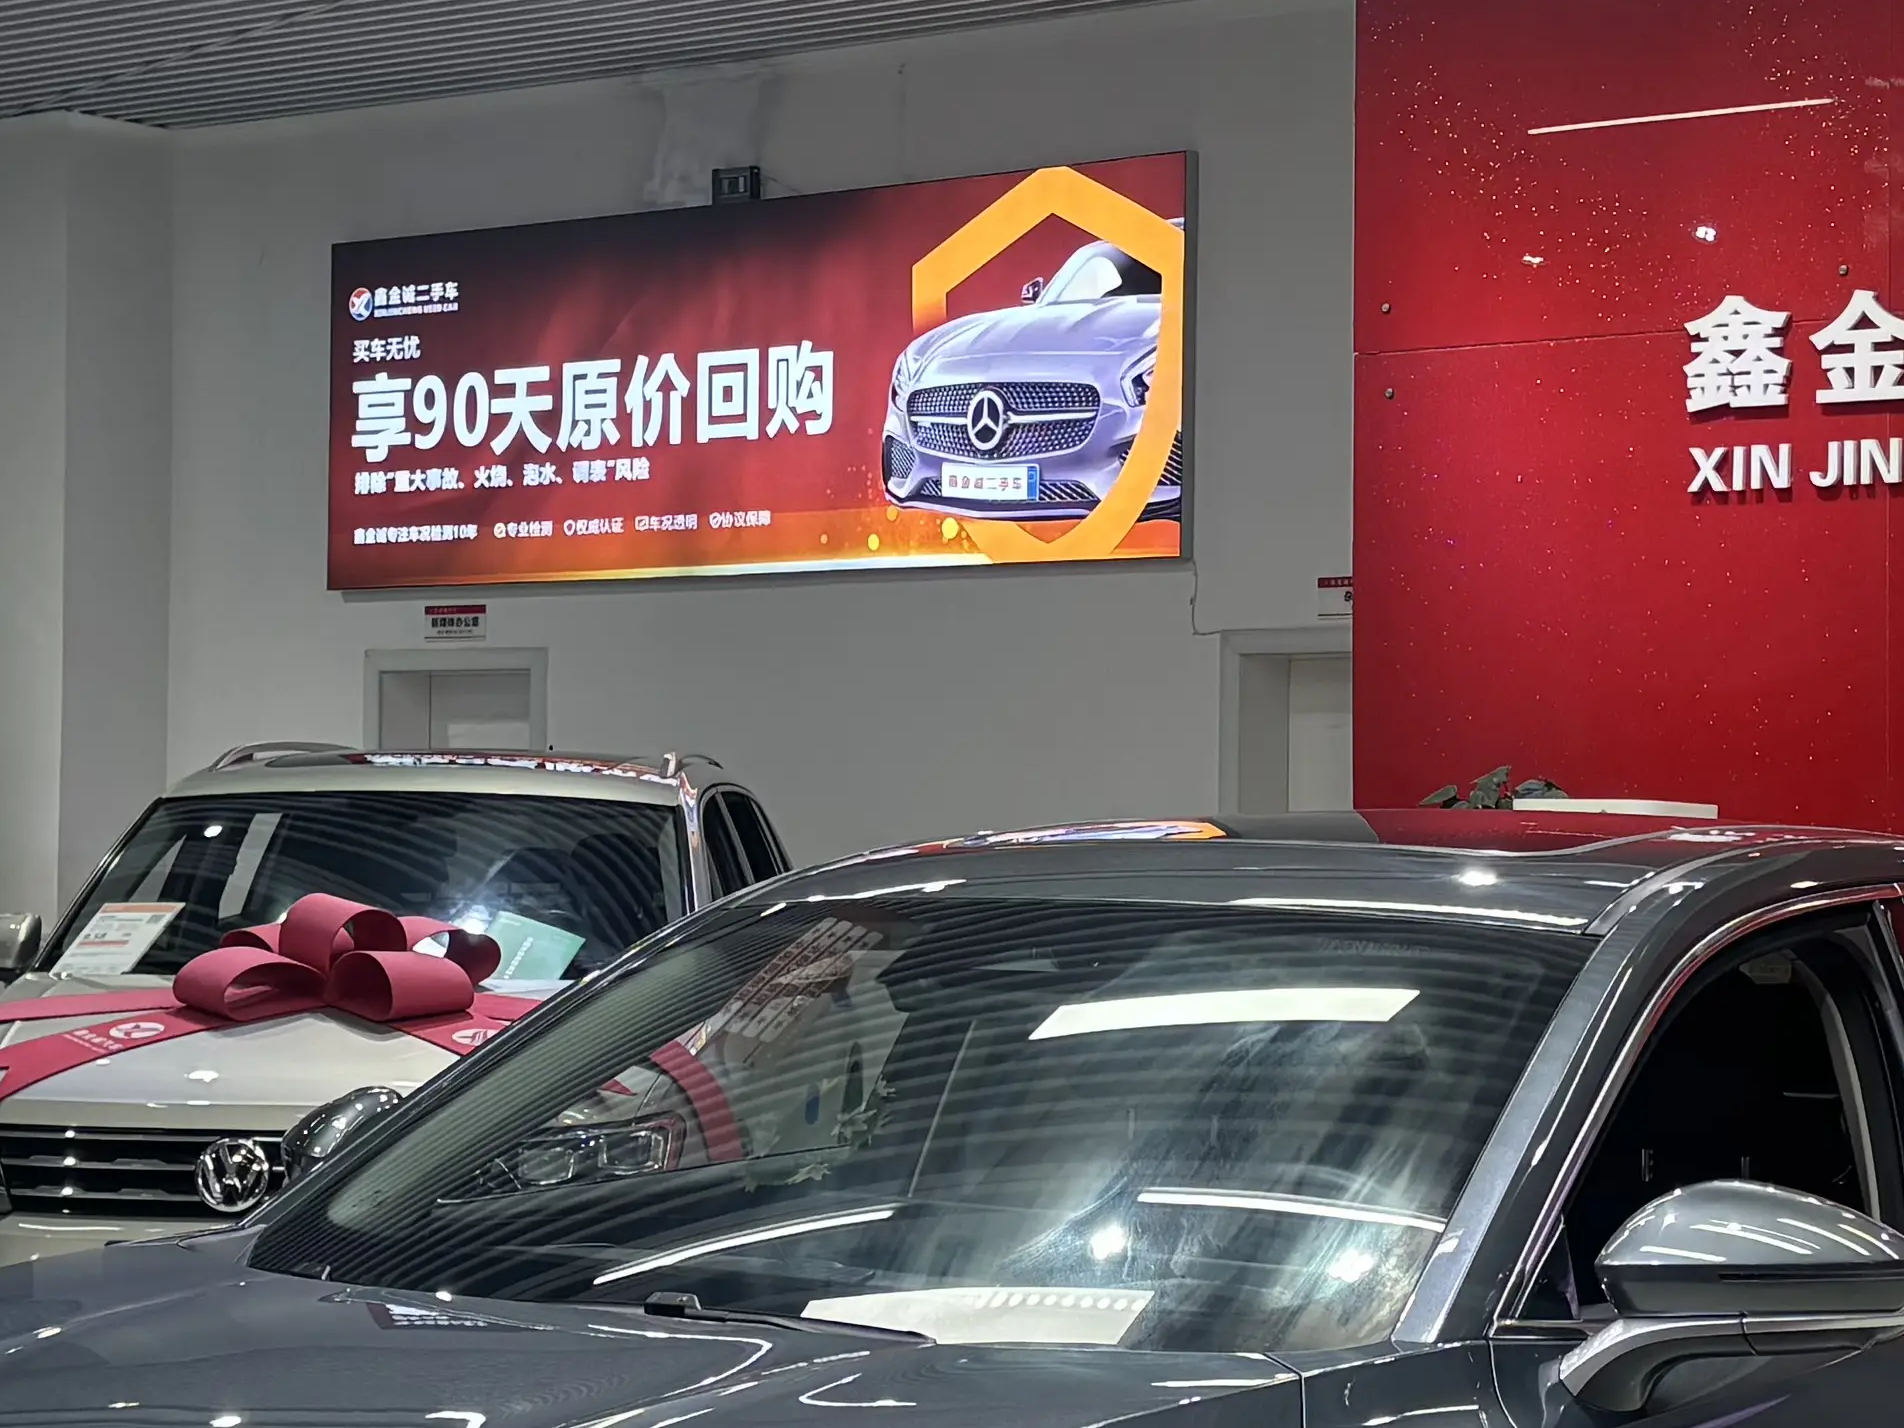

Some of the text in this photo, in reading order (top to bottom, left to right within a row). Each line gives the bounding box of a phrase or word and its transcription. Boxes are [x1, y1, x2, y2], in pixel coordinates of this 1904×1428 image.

[374, 281, 459, 307] 鑫金诚二手车
[353, 335, 421, 363] 买车无忧
[351, 340, 834, 463] 享90天原价回购
[1686, 442, 1793, 494] XIN
[506, 520, 553, 538] 专业检测
[576, 517, 625, 535] 权威认证
[648, 514, 698, 532] 车况透明
[721, 510, 771, 528] 协议保障
